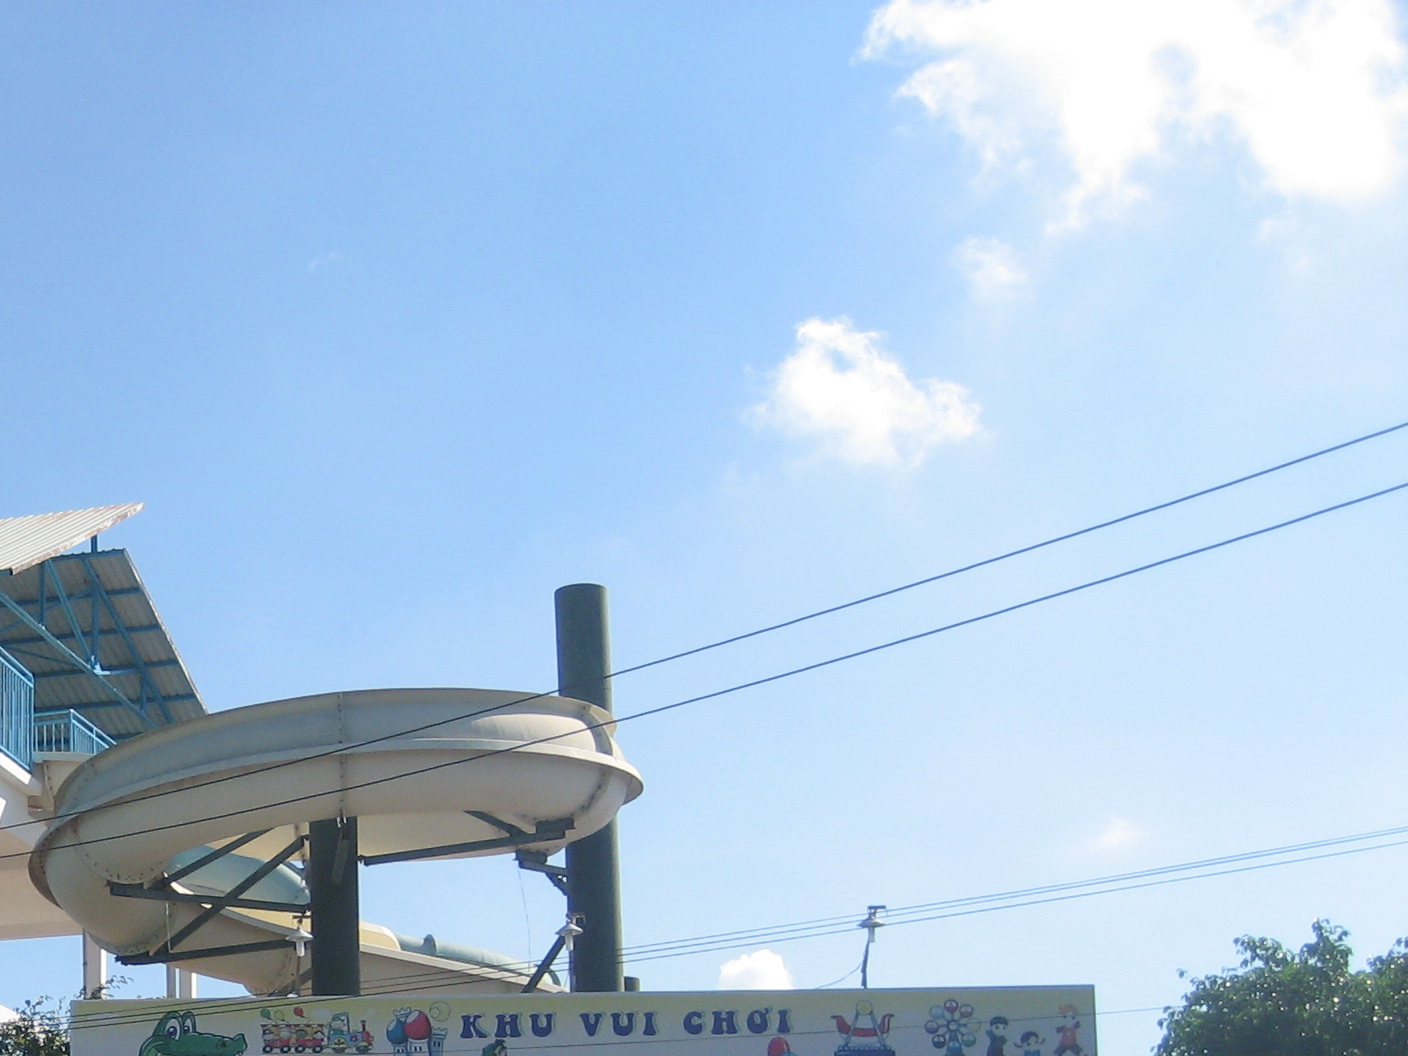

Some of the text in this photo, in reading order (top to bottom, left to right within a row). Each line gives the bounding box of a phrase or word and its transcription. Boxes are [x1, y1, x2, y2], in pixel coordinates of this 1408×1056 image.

[459, 1006, 792, 1040] KHU VUI CHƠI
